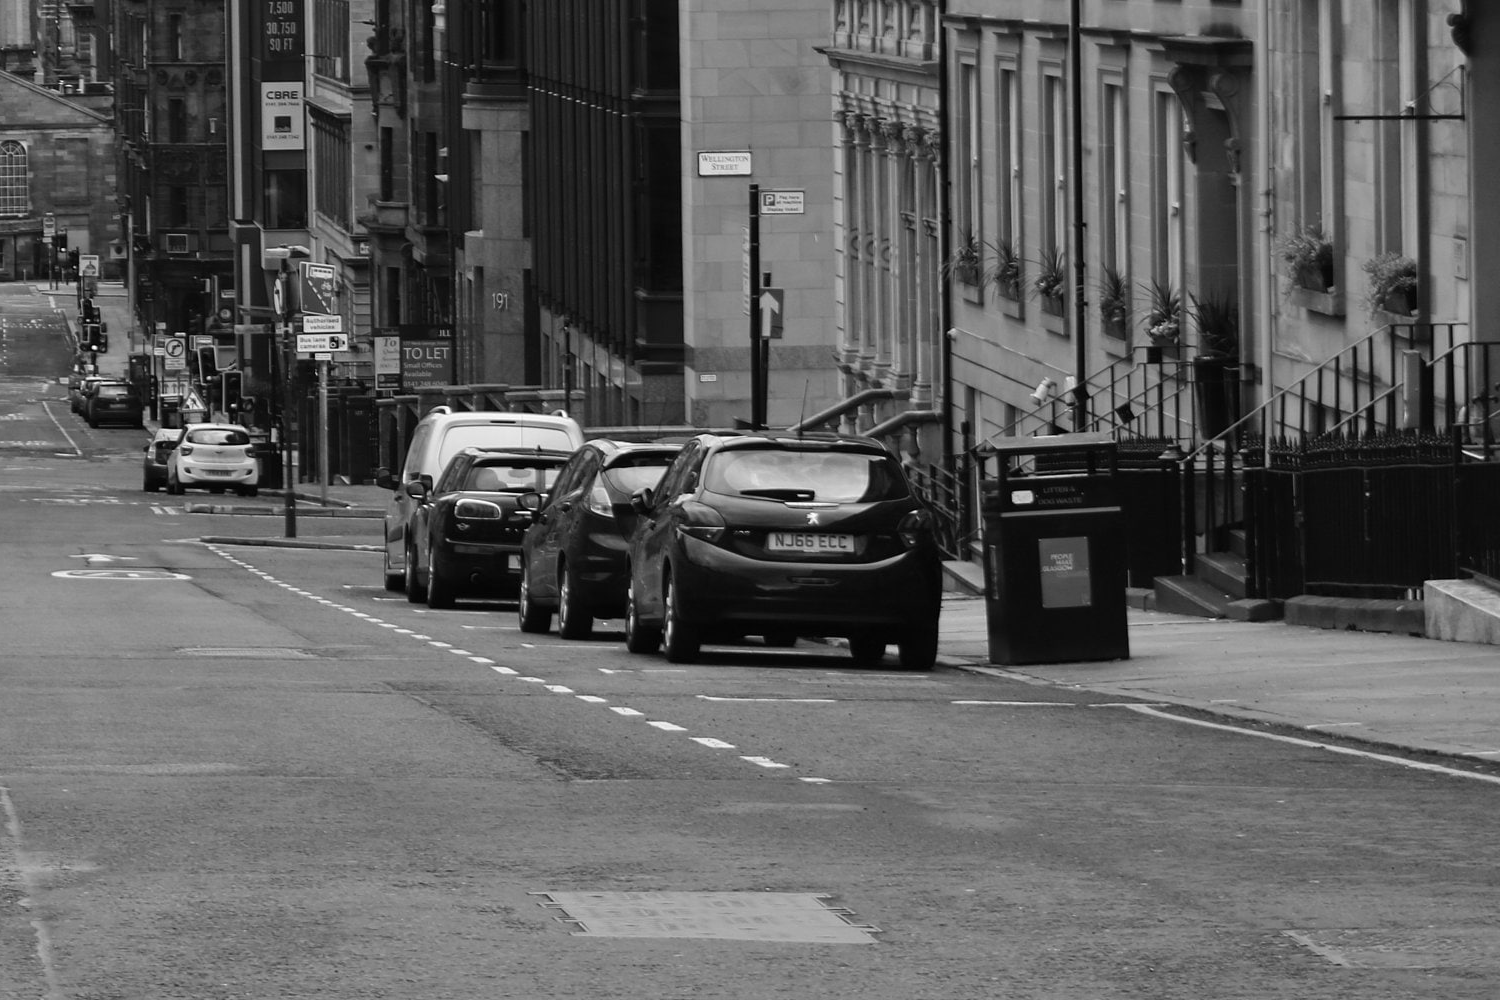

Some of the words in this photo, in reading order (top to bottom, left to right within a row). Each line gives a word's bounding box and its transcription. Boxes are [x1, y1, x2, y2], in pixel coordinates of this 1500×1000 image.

[266, 22, 296, 35] 30,750
[270, 38, 281, 51] SQ
[283, 37, 293, 50] FT
[266, 90, 299, 100] CBRE
[712, 163, 739, 171] STREET
[492, 292, 508, 309] 191
[383, 338, 396, 347] To
[403, 347, 423, 359] TO
[426, 347, 450, 359] LET
[775, 534, 814, 548] NJ66
[818, 535, 847, 549] ECC
